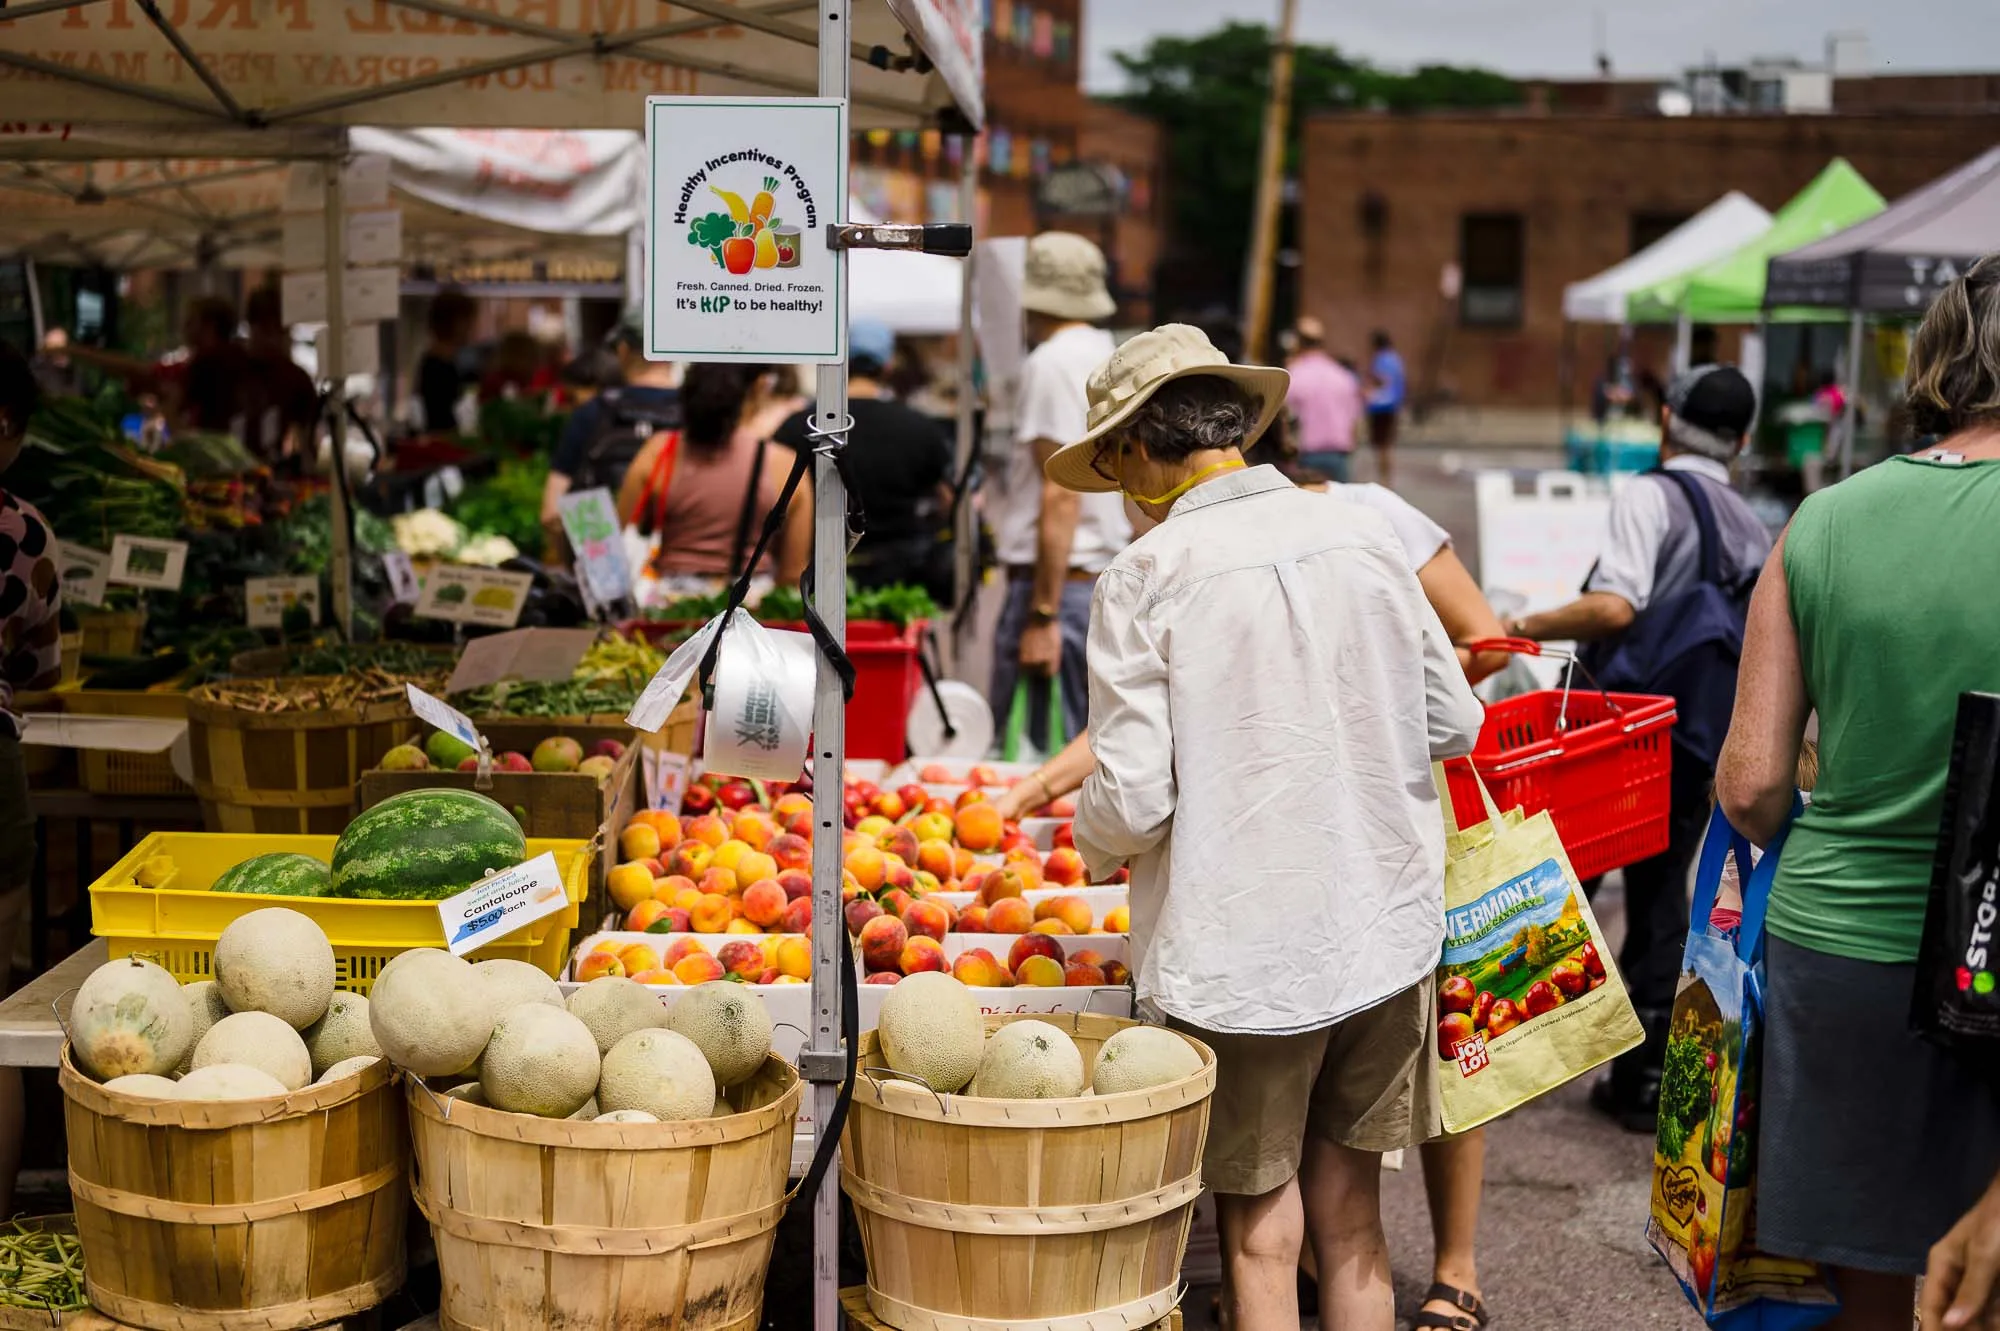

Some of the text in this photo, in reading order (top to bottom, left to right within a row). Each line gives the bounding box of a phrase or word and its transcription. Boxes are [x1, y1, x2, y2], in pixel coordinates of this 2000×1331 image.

[674, 148, 817, 229] Healthy Incentives Program
[676, 281, 824, 293] Fresh. Canned. Dried. Frozen.
[676, 295, 823, 314] It's HIP to be healthy!
[463, 880, 538, 918] Cantaloupe
[1446, 876, 1537, 937] VERMONT
[1449, 899, 1536, 947] VILLAGE CANNERY
[1540, 1015, 1561, 1028] Natural
[1457, 1041, 1486, 1062] JOB
[1461, 1054, 1488, 1076] LOT
